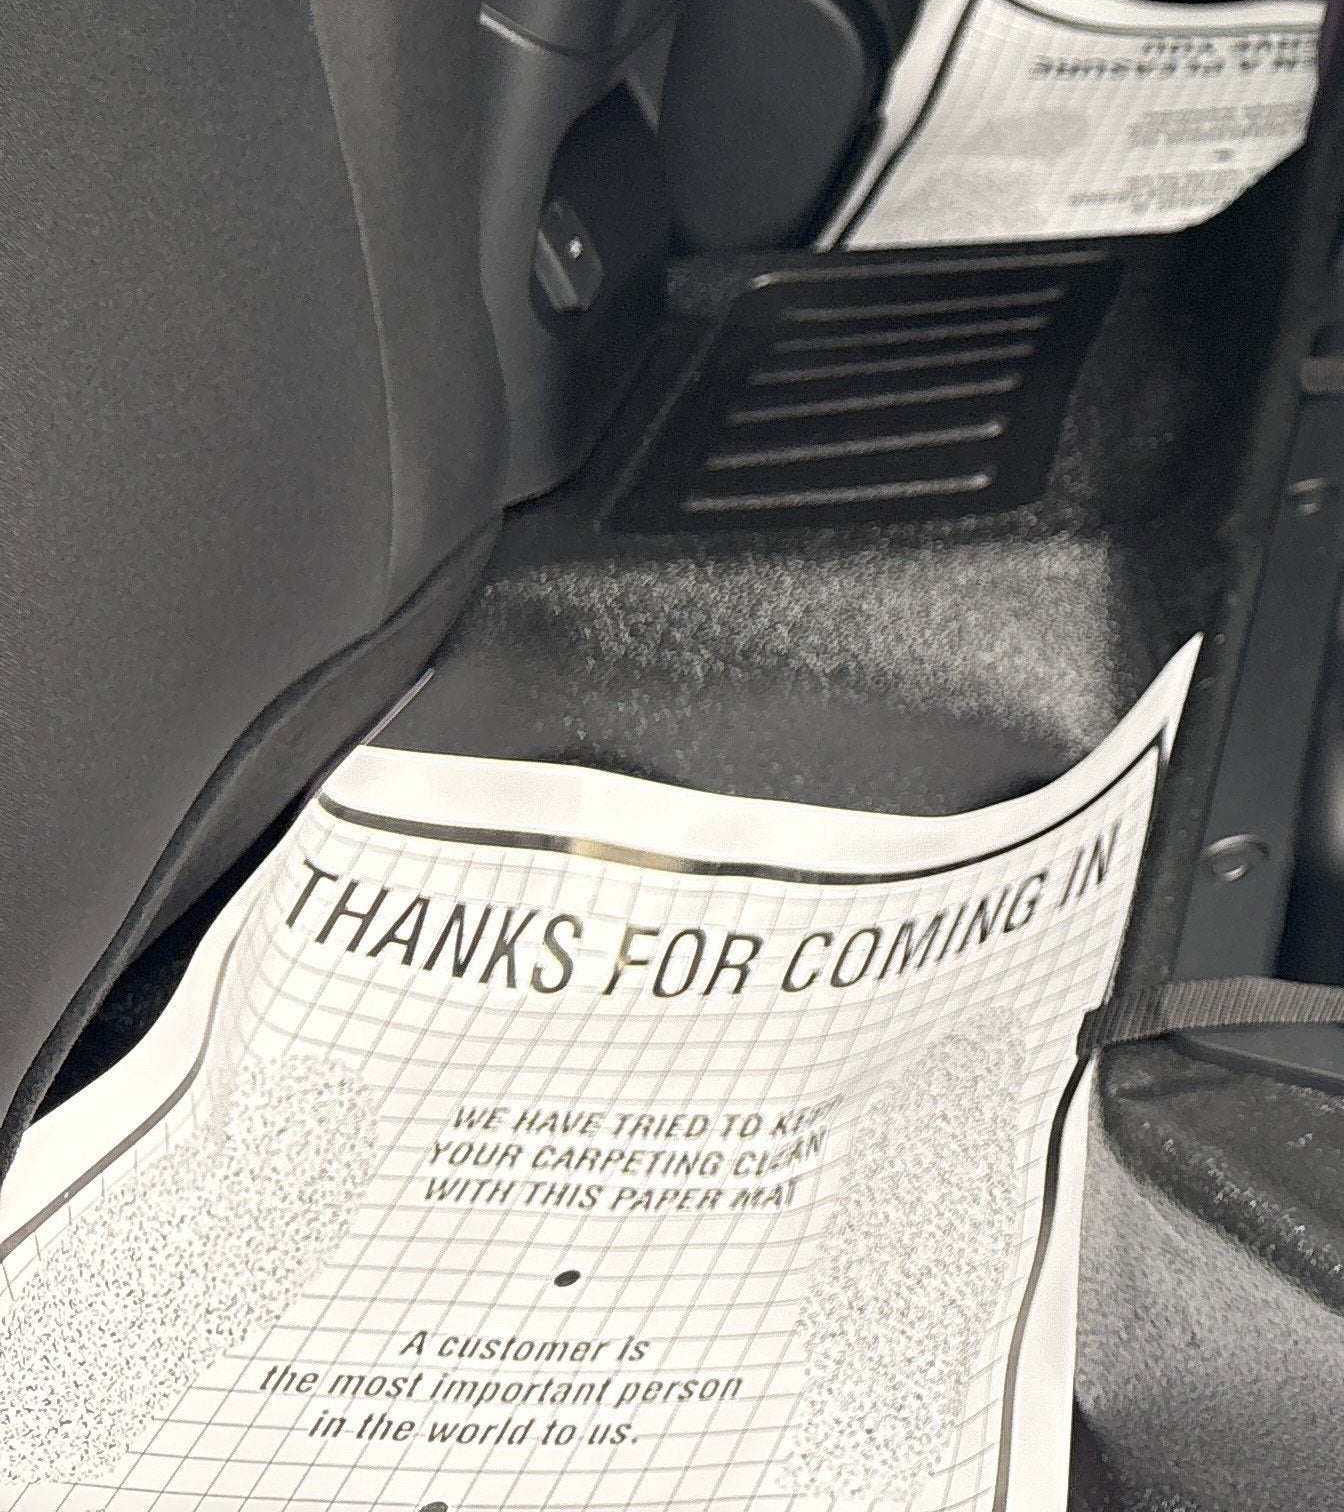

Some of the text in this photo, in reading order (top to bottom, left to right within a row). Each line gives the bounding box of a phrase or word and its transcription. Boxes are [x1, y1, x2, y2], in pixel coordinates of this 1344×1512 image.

[284, 821, 1121, 999] THANKS FOR COMING IN
[453, 1105, 510, 1132] WE
[513, 1107, 607, 1137] HAVE
[611, 1112, 710, 1140] TRIED
[720, 1111, 763, 1140] TO
[429, 1140, 524, 1168] YOUR
[530, 1144, 724, 1178] CARPETING
[424, 1174, 800, 1212] WITH THIS PAPER MAT
[398, 1329, 650, 1362] A customer is
[259, 1364, 744, 1410] the most important person
[307, 1408, 638, 1446] in the world to us.
